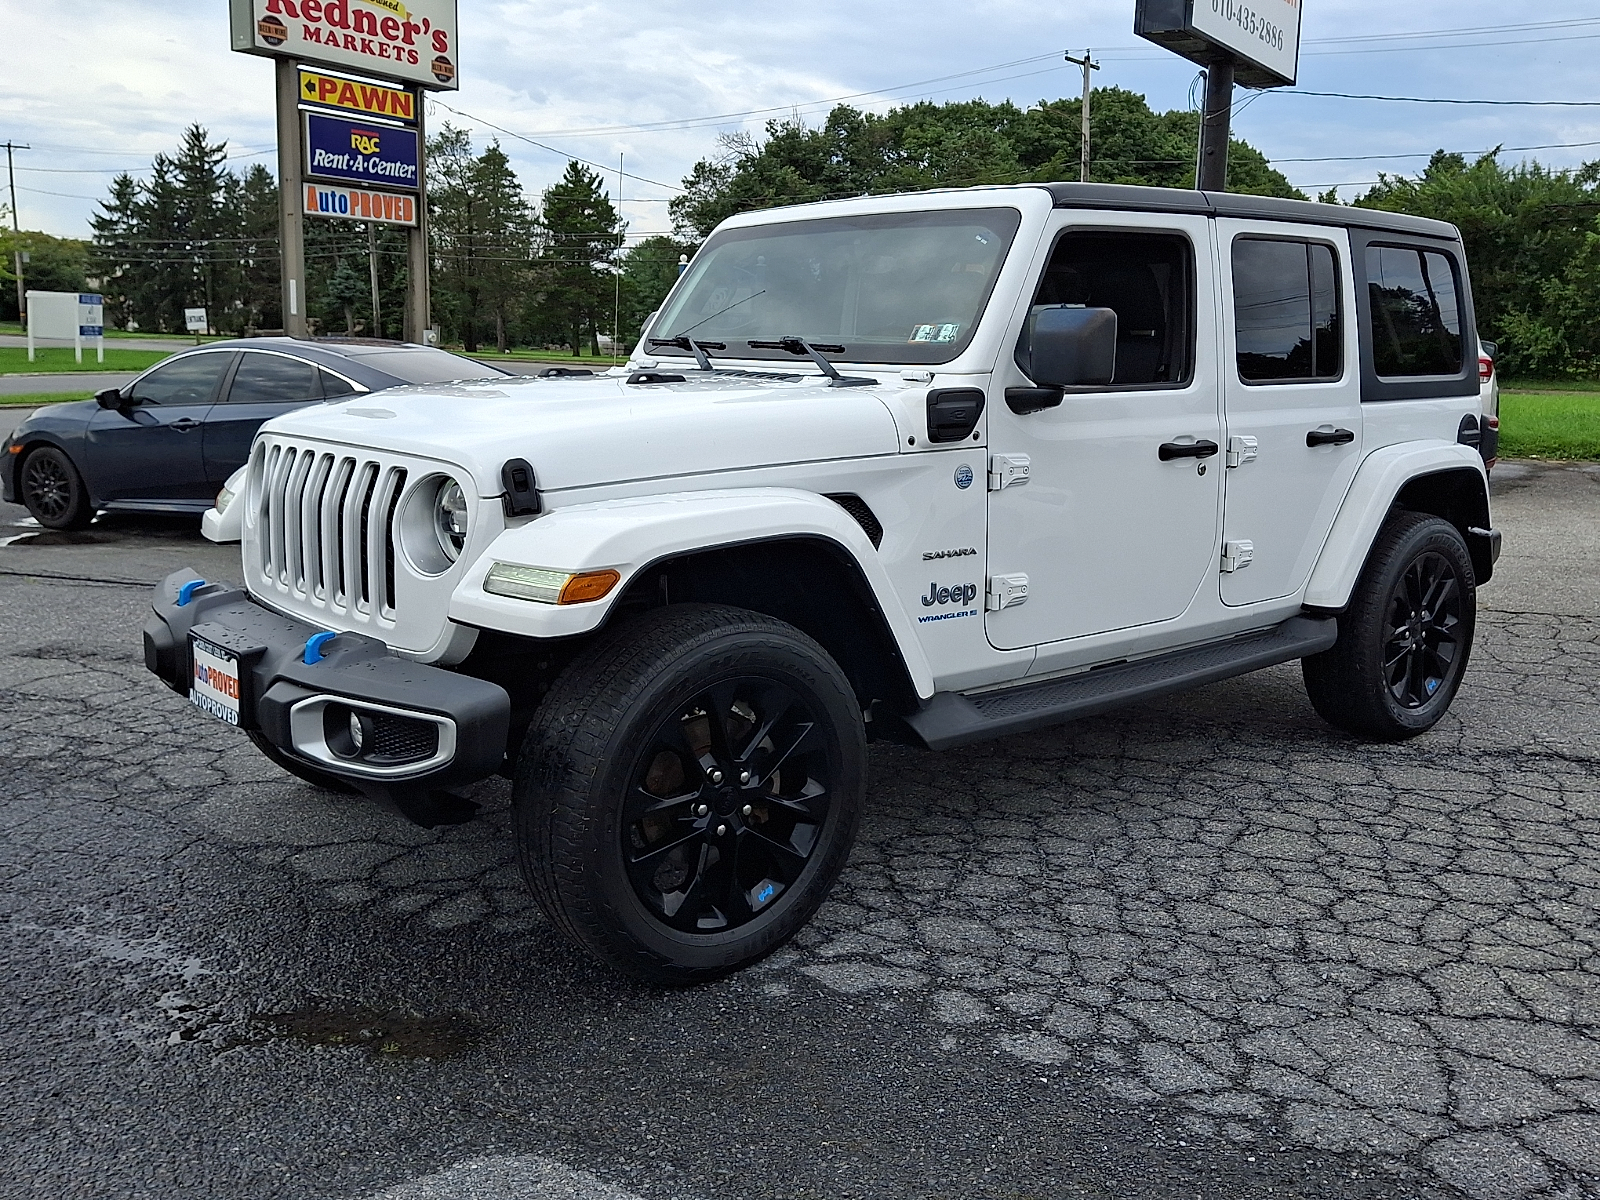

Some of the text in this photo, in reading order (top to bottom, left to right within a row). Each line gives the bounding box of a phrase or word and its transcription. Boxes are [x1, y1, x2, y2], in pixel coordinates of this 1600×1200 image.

[370, 0, 399, 12] wned
[302, 24, 419, 65] MARKETS
[318, 77, 411, 117] PAWN
[351, 134, 380, 155] RAC
[922, 547, 978, 561] SAHARA
[921, 582, 977, 607] Jeep
[917, 610, 969, 624] WRANGLER
[189, 688, 239, 726] AUTOPROVED
